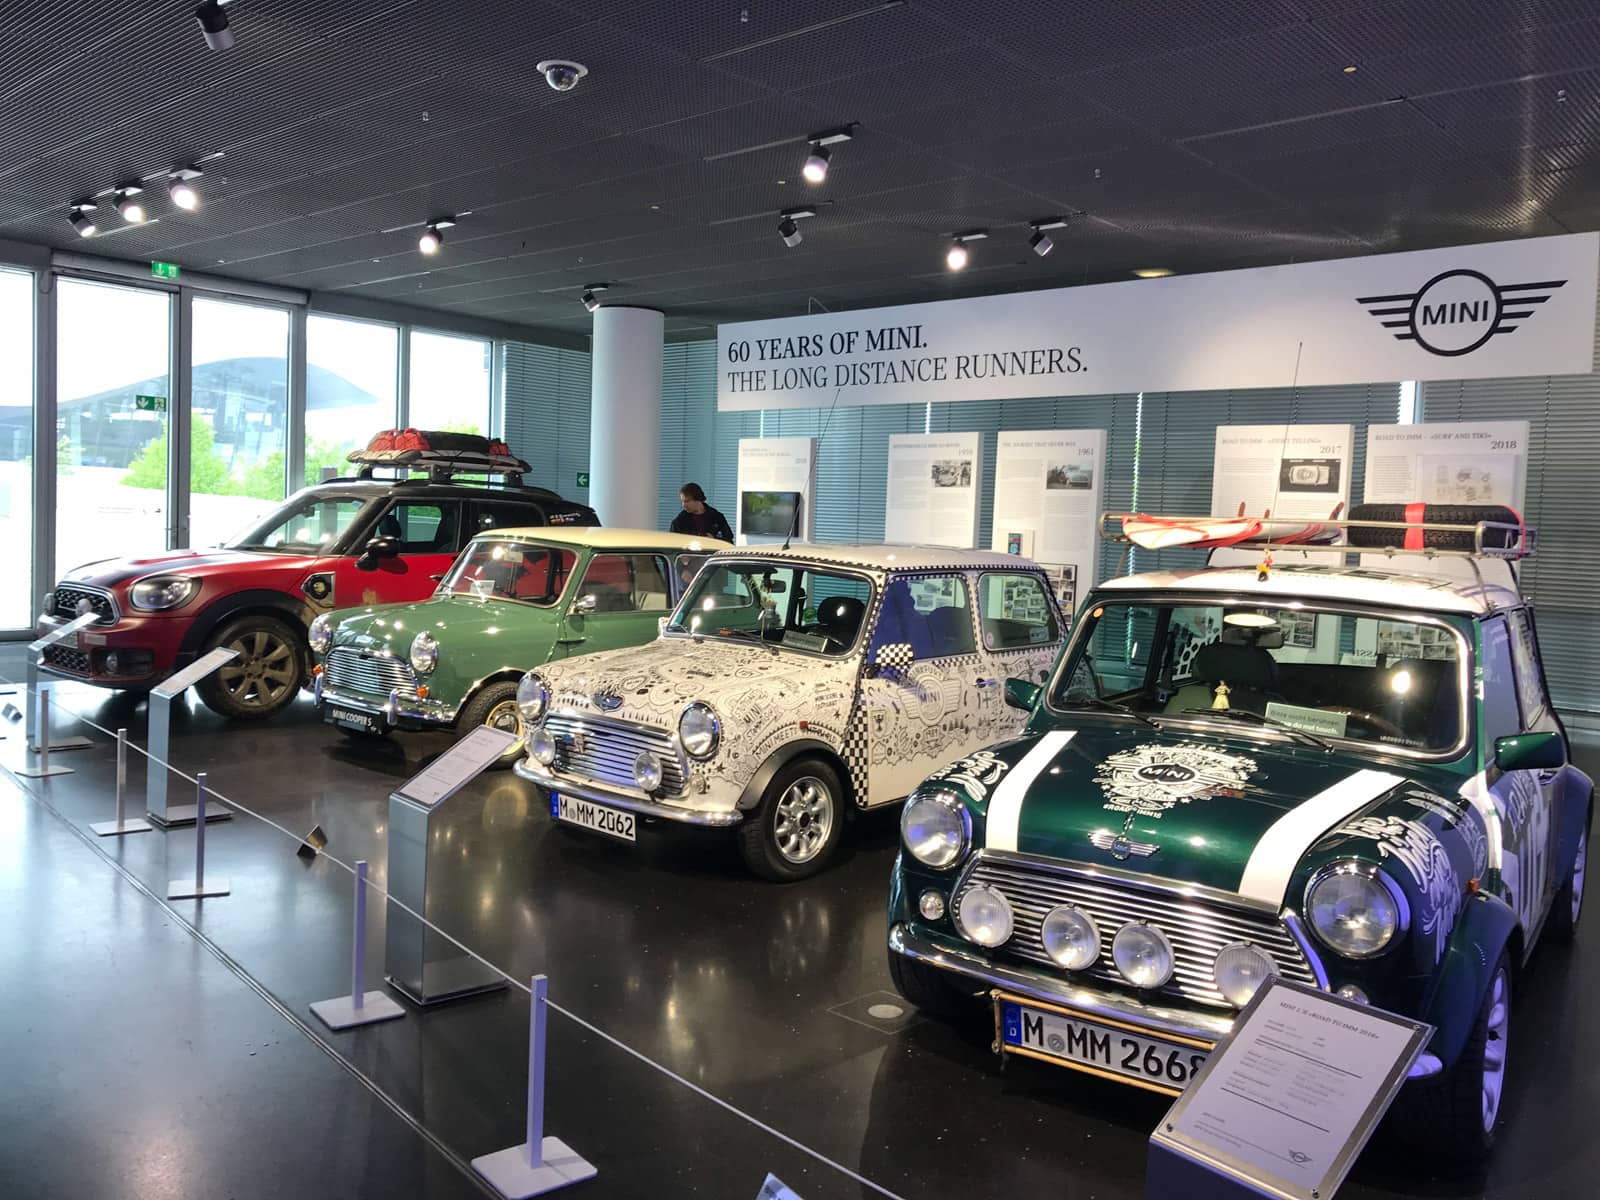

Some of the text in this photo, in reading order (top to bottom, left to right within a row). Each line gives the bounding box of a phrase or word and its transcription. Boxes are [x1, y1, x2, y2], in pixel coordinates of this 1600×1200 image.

[1422, 300, 1489, 326] MINI
[727, 325, 928, 363] 60 YEARS OF MINI.
[727, 347, 1088, 393] THE LONG DISTANCE RUNNERS.
[1320, 446, 1343, 454] 2017
[1490, 440, 1517, 450] 2018
[1142, 767, 1191, 780] MINI
[559, 796, 634, 838] M MM 2062
[1023, 1013, 1044, 1046] M
[1067, 1023, 1111, 1065] MM
